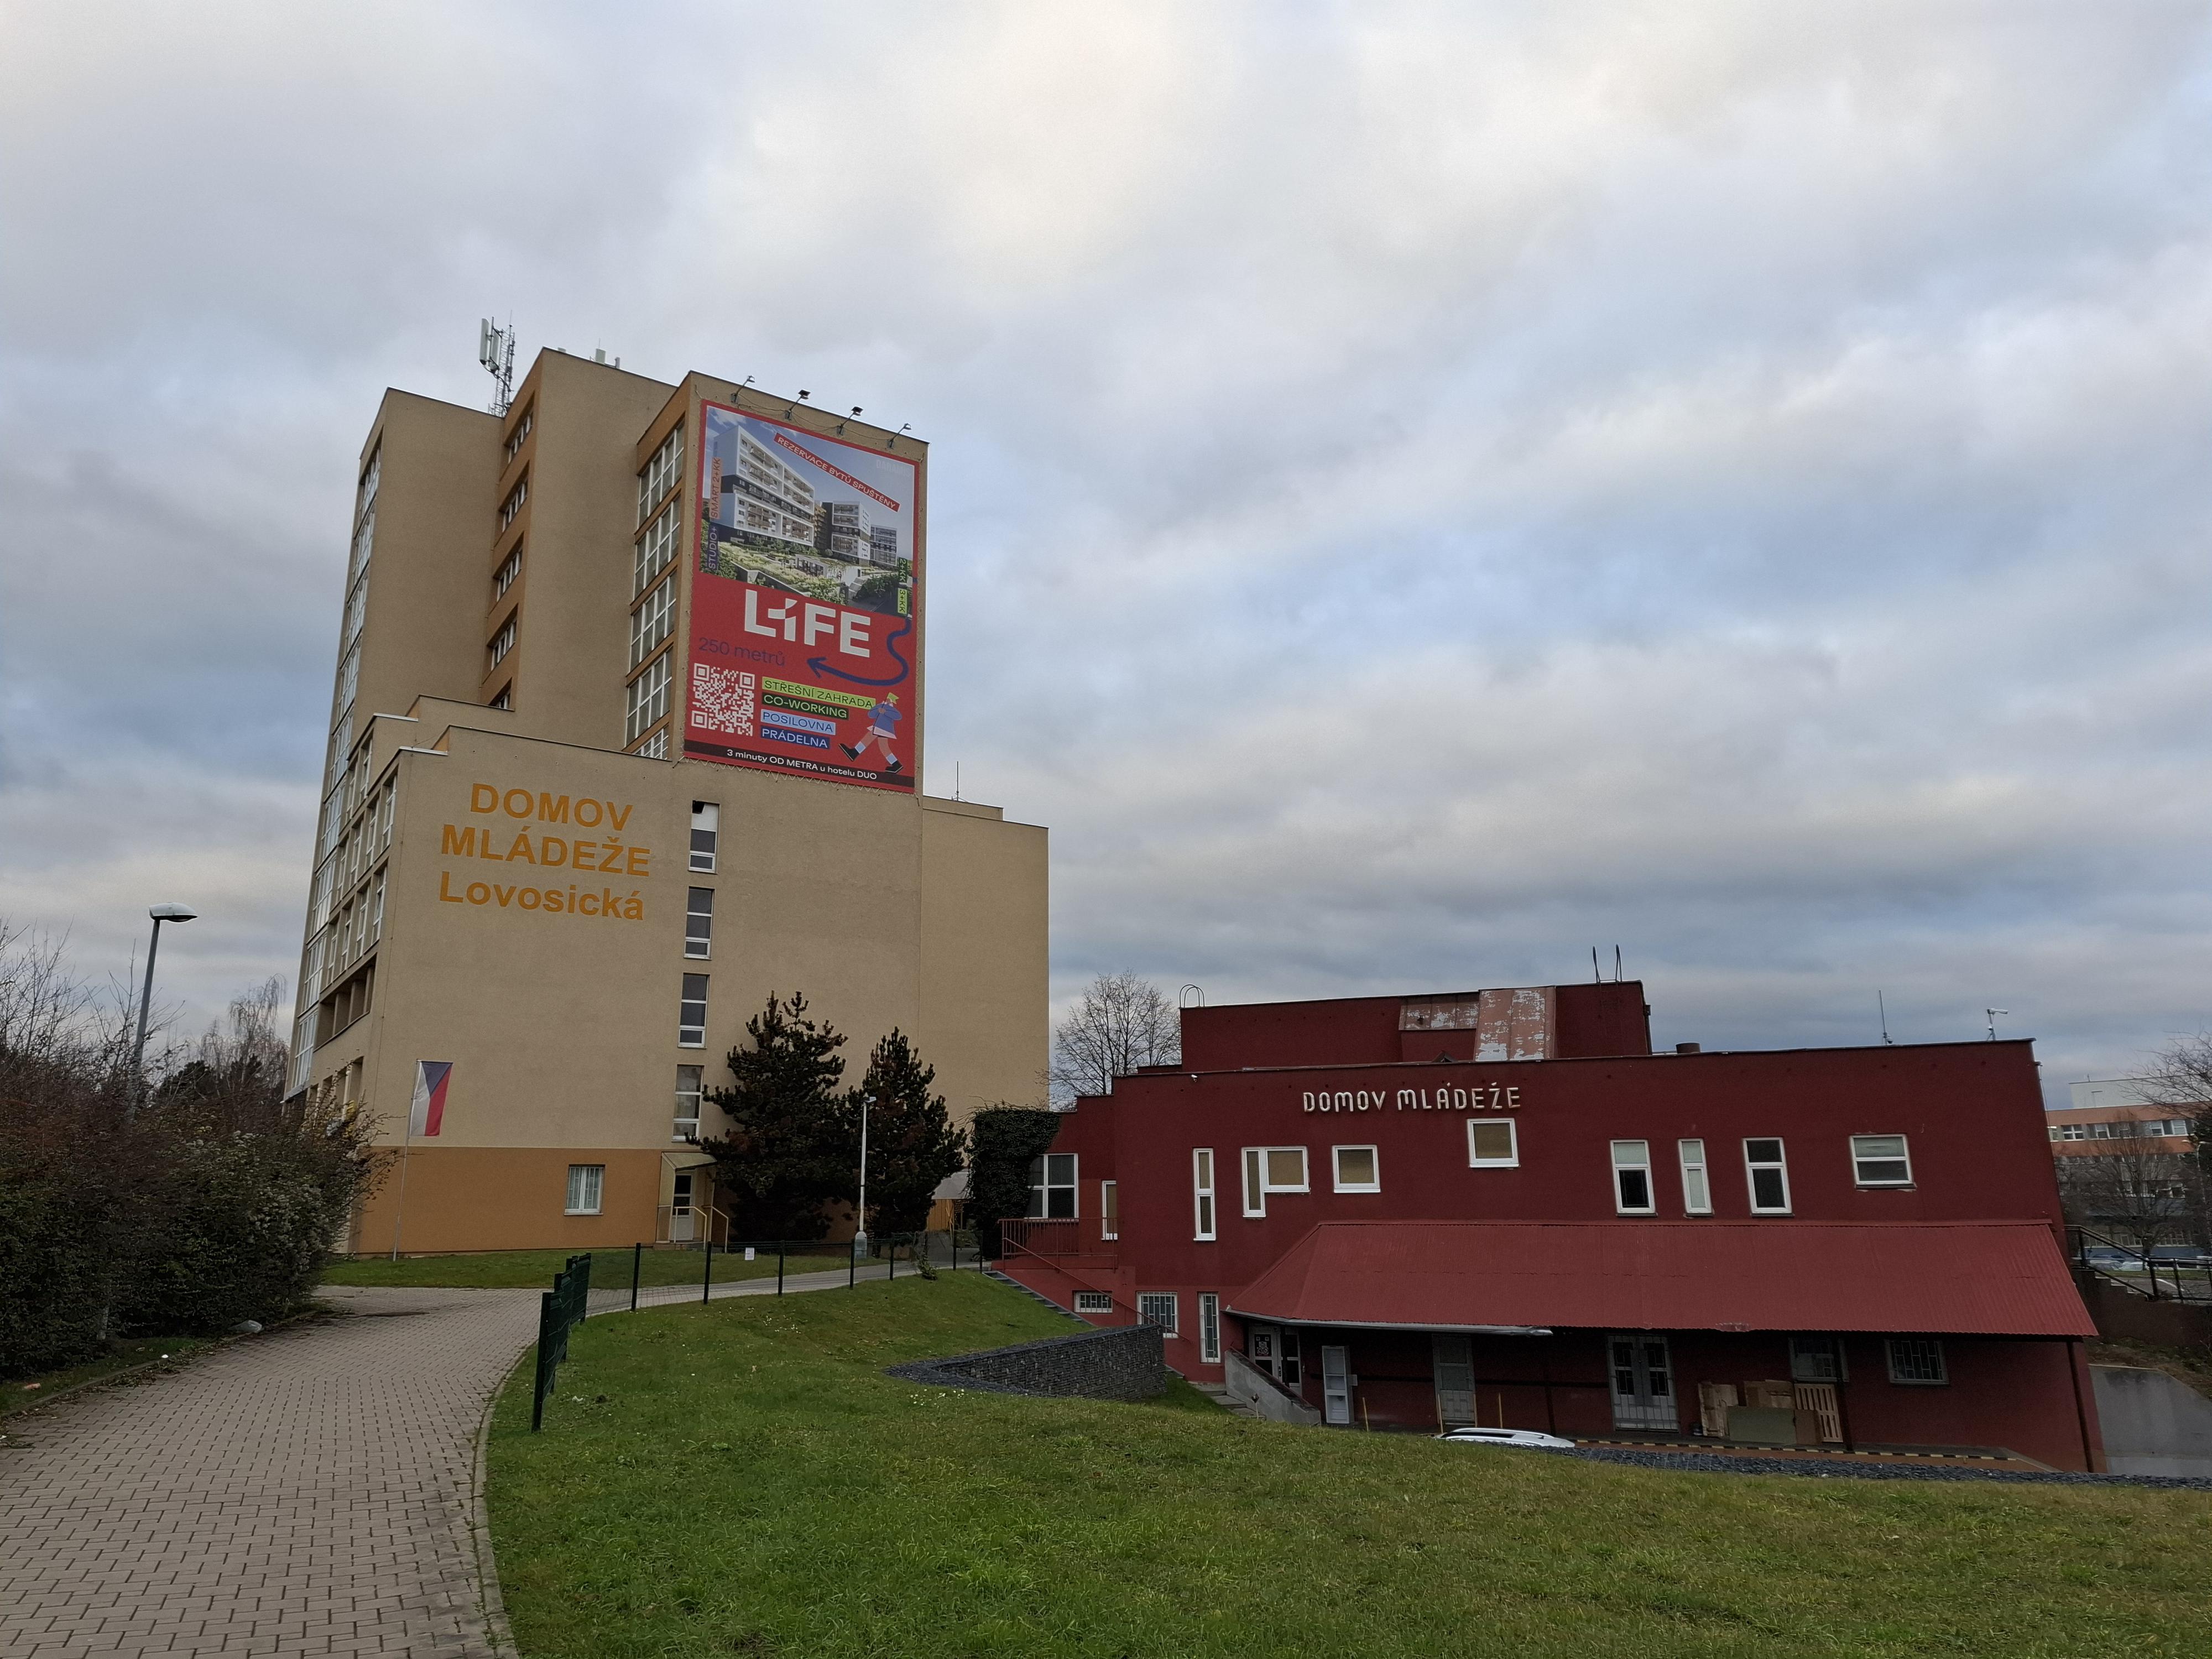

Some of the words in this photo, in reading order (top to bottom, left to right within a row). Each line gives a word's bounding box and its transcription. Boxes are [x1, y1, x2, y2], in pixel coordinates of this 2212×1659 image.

[712, 457, 721, 483] 2+KK
[778, 437, 828, 470] REZERVACE
[830, 468, 851, 484] BYTŮ
[852, 481, 896, 509] SPUŠTĚNY
[708, 526, 717, 570] STUDIO+
[698, 637, 730, 655] 250
[734, 646, 785, 666] metrů
[764, 680, 815, 698] STŘEŠNÍ
[817, 691, 873, 708] ZAHRADA
[764, 695, 847, 718] CO-WORKING
[763, 712, 833, 733] POSILOVNA
[762, 728, 828, 748] PRÁDELNA
[735, 750, 768, 763] minuty
[769, 756, 784, 765] OD
[786, 759, 818, 770] METRA
[827, 765, 855, 776] hotelu
[857, 771, 877, 780] DUO
[471, 782, 633, 831] DOMOV
[441, 824, 651, 877] MLÁDEŽE
[440, 870, 644, 921] Lovosická
[1303, 1091, 1386, 1113] DOMOV
[1397, 1082, 1521, 1111] MLÁDEŽE
